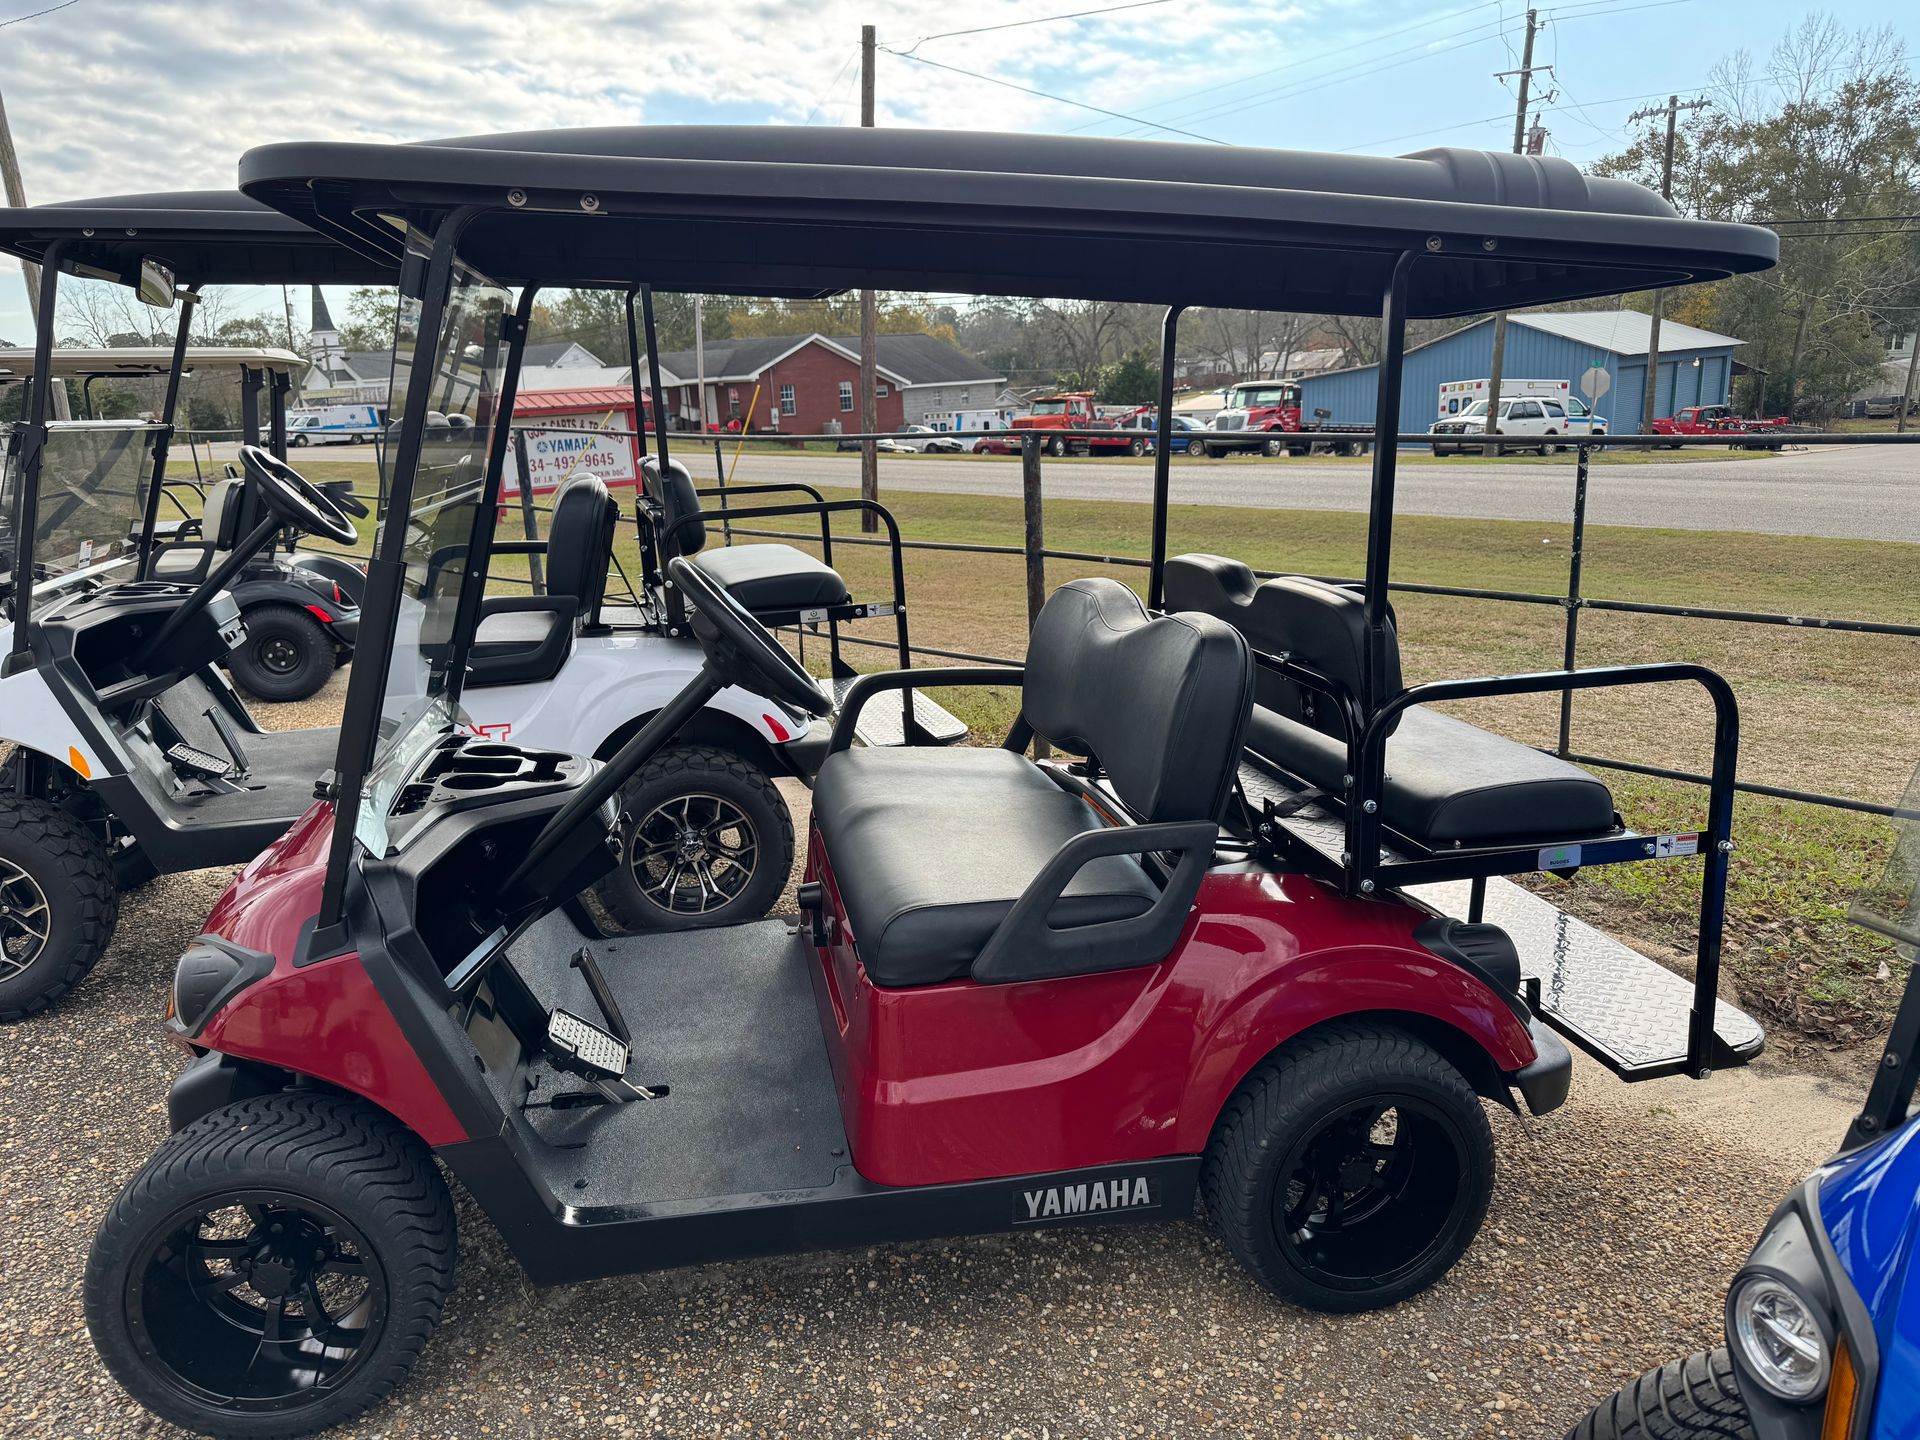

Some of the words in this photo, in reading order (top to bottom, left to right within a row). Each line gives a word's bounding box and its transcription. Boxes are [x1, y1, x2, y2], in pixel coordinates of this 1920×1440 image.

[589, 421, 624, 444] TRILERS
[549, 436, 597, 453] YAMAHA
[529, 452, 615, 473] 34-493-9645
[1024, 1177, 1150, 1218] YAMAHA
